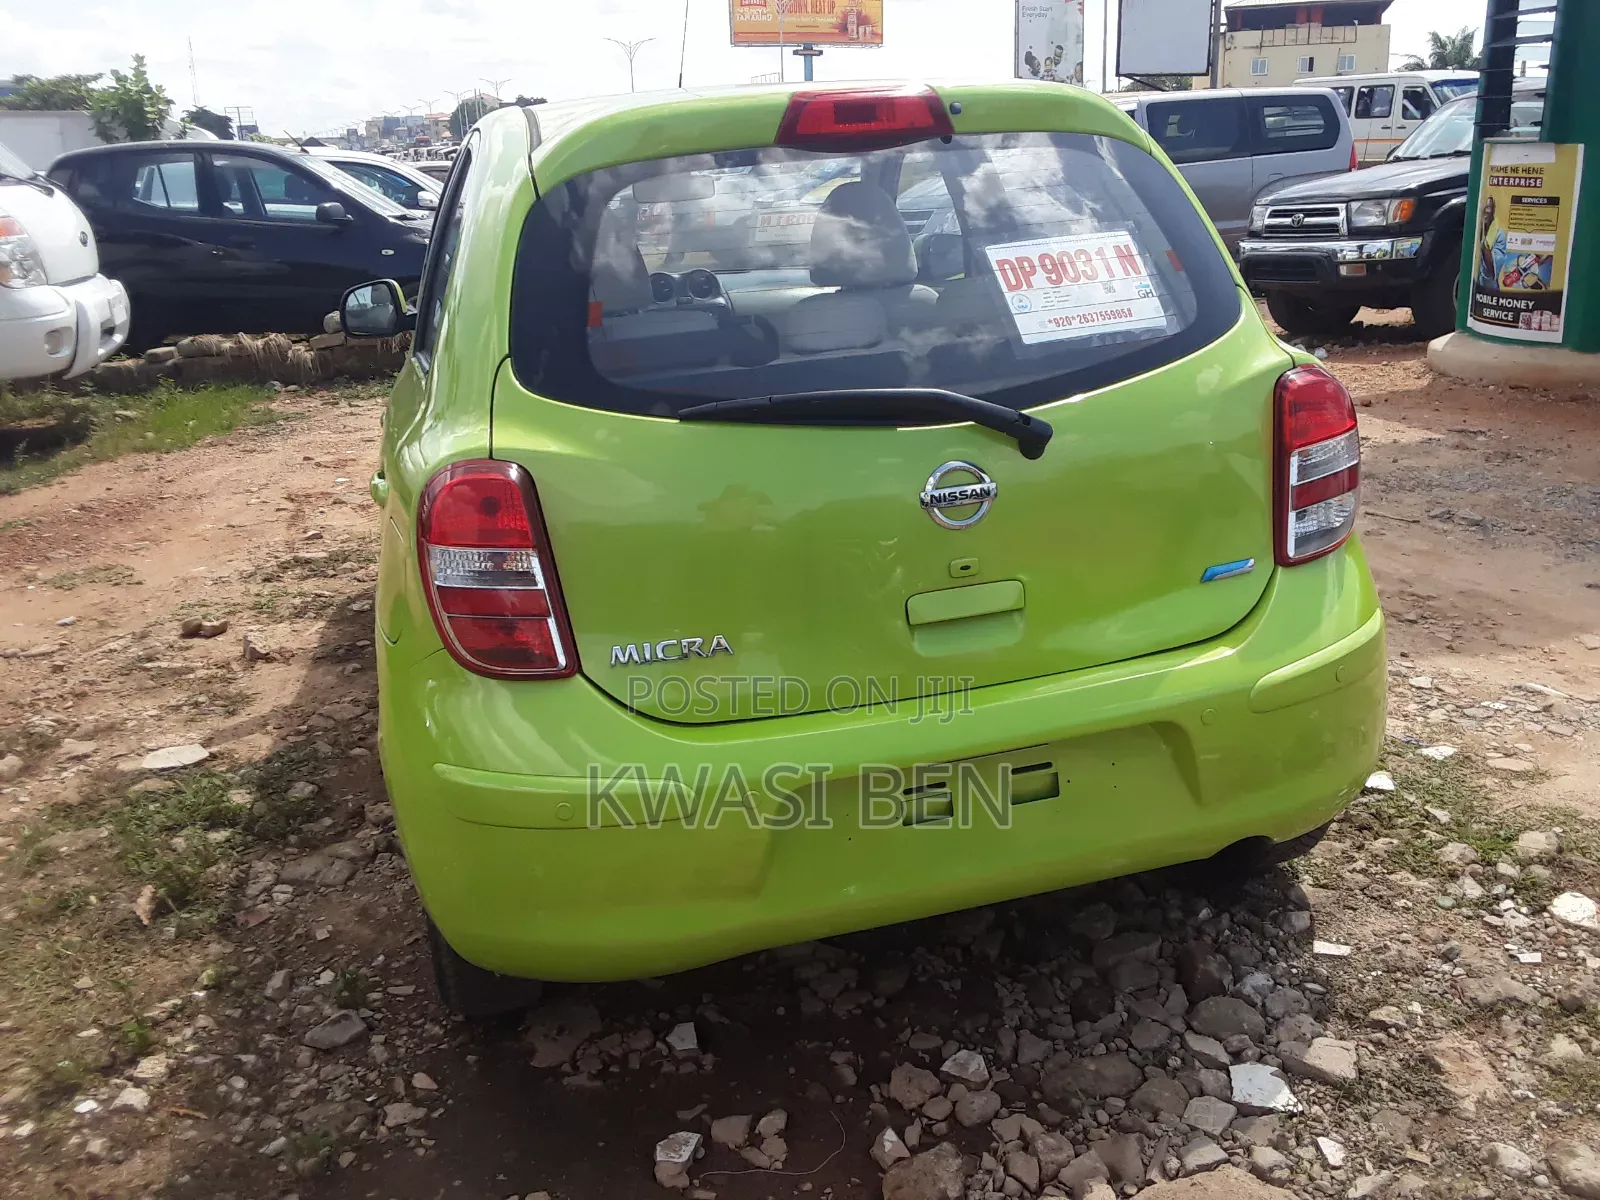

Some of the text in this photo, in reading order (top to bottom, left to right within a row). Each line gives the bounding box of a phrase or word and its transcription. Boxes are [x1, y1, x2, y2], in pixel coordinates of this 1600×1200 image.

[1490, 177, 1542, 187] ENTERPRISE
[995, 244, 1142, 291] DP 9031 N
[1137, 289, 1154, 299] GH
[1475, 293, 1535, 310] MOBILE MONEY
[1482, 308, 1514, 321] SERVICE
[929, 486, 991, 504] NISSAN
[609, 634, 734, 667] MICRA
